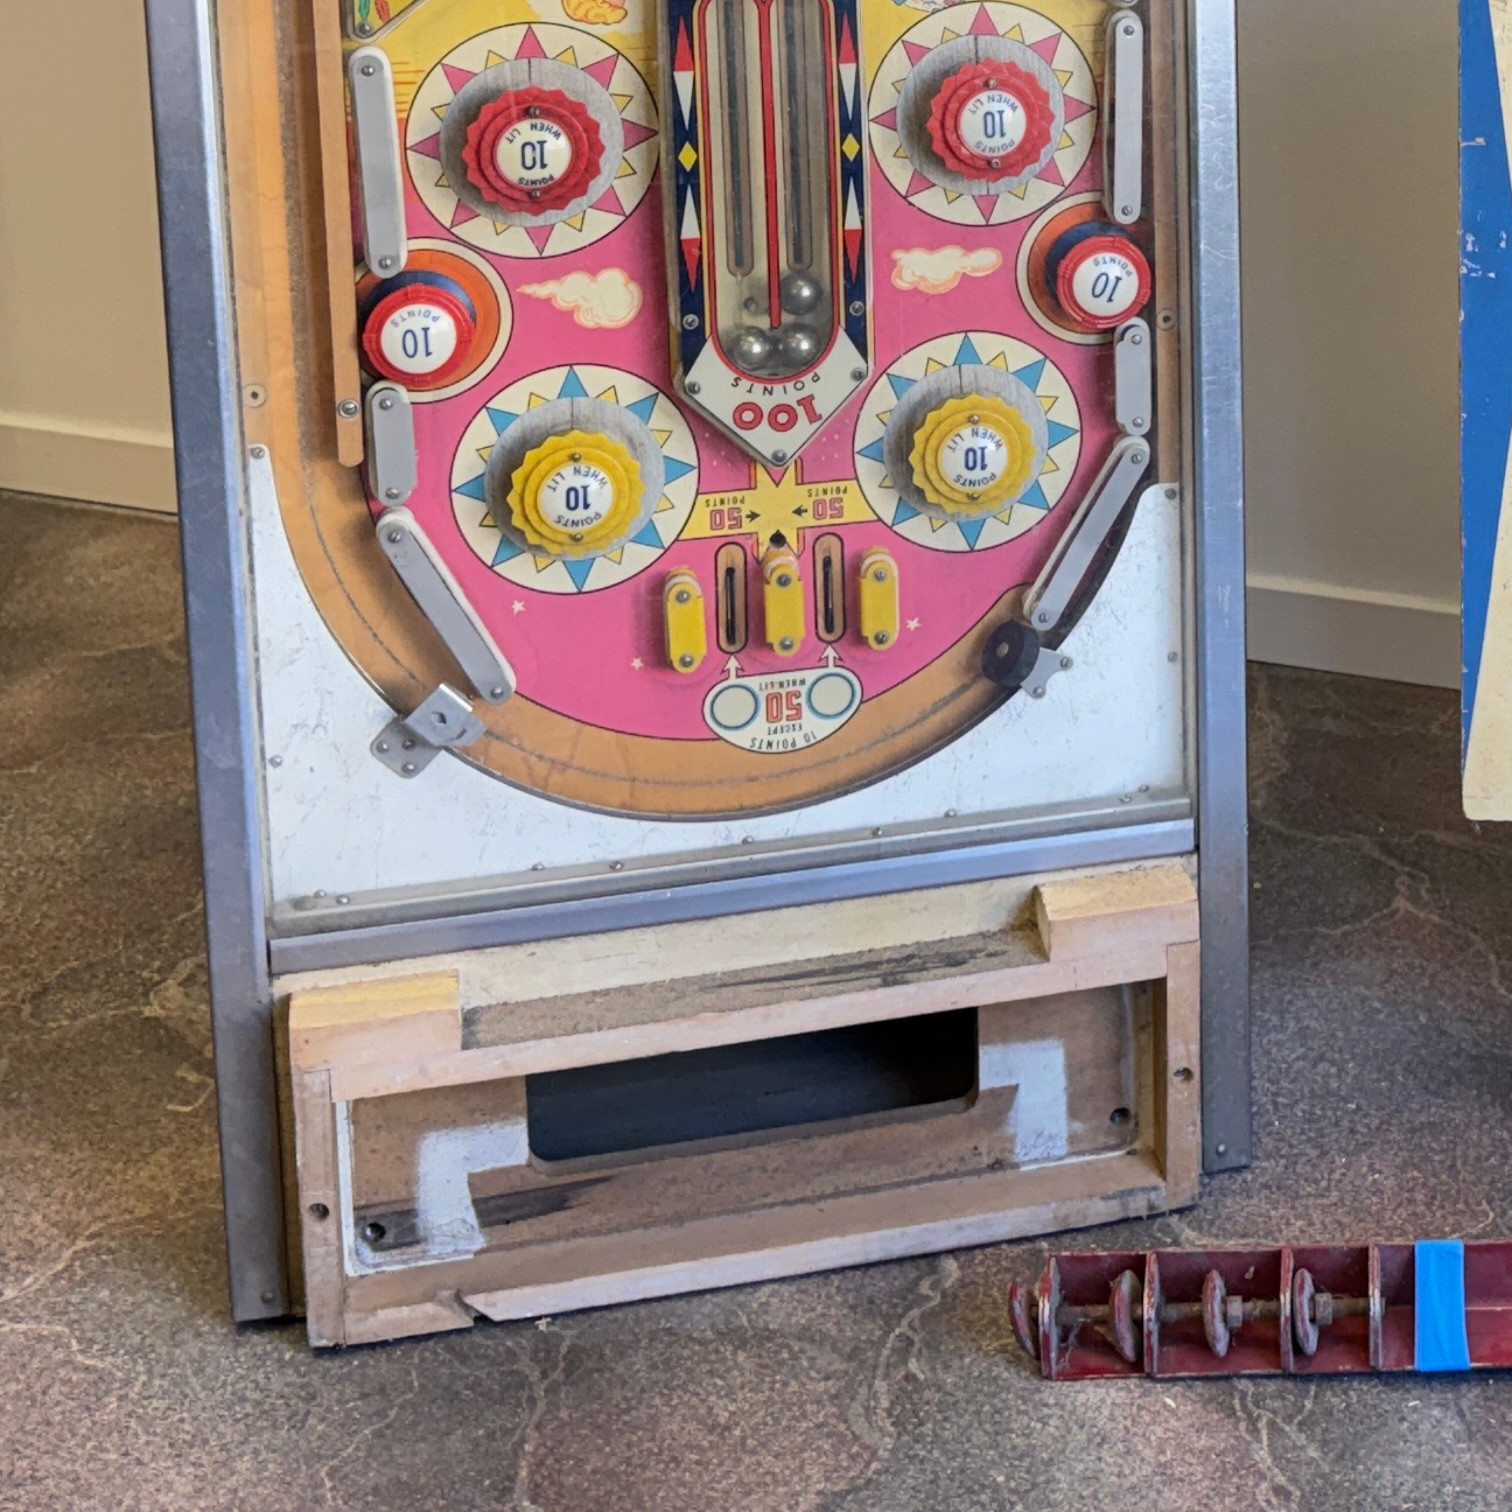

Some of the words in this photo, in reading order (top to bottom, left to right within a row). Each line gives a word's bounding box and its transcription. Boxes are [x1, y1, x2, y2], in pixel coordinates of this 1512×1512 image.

[968, 99, 983, 115] LIT
[987, 94, 1018, 112] WHEN
[530, 123, 561, 140] WHEN
[983, 110, 1006, 139] 10
[505, 128, 520, 144] LIT
[975, 139, 1015, 153] POINTS
[520, 140, 548, 171] 10
[518, 174, 554, 186] POINTS
[1093, 257, 1133, 277] POINTS
[1091, 272, 1122, 303] 10
[391, 308, 440, 328] POINTS
[402, 327, 432, 359] 10
[731, 372, 820, 396] POINTS
[733, 394, 822, 433] 100
[946, 433, 964, 453] LIT
[971, 428, 1003, 451] WHEN
[964, 446, 988, 471] 10
[547, 472, 565, 492] LIT
[573, 466, 608, 489] WHEN
[953, 472, 996, 487] POINTS
[566, 485, 591, 511] 10
[807, 485, 848, 497] POINTS
[705, 495, 745, 508] POINTS
[812, 497, 844, 520] 50
[554, 512, 602, 527] POINTS
[710, 507, 743, 531] 50
[778, 678, 806, 689] WHEN
[765, 690, 802, 724] 50
[767, 723, 802, 736] EXCEPT
[803, 730, 817, 743] 10
[749, 736, 796, 750] POINTS
